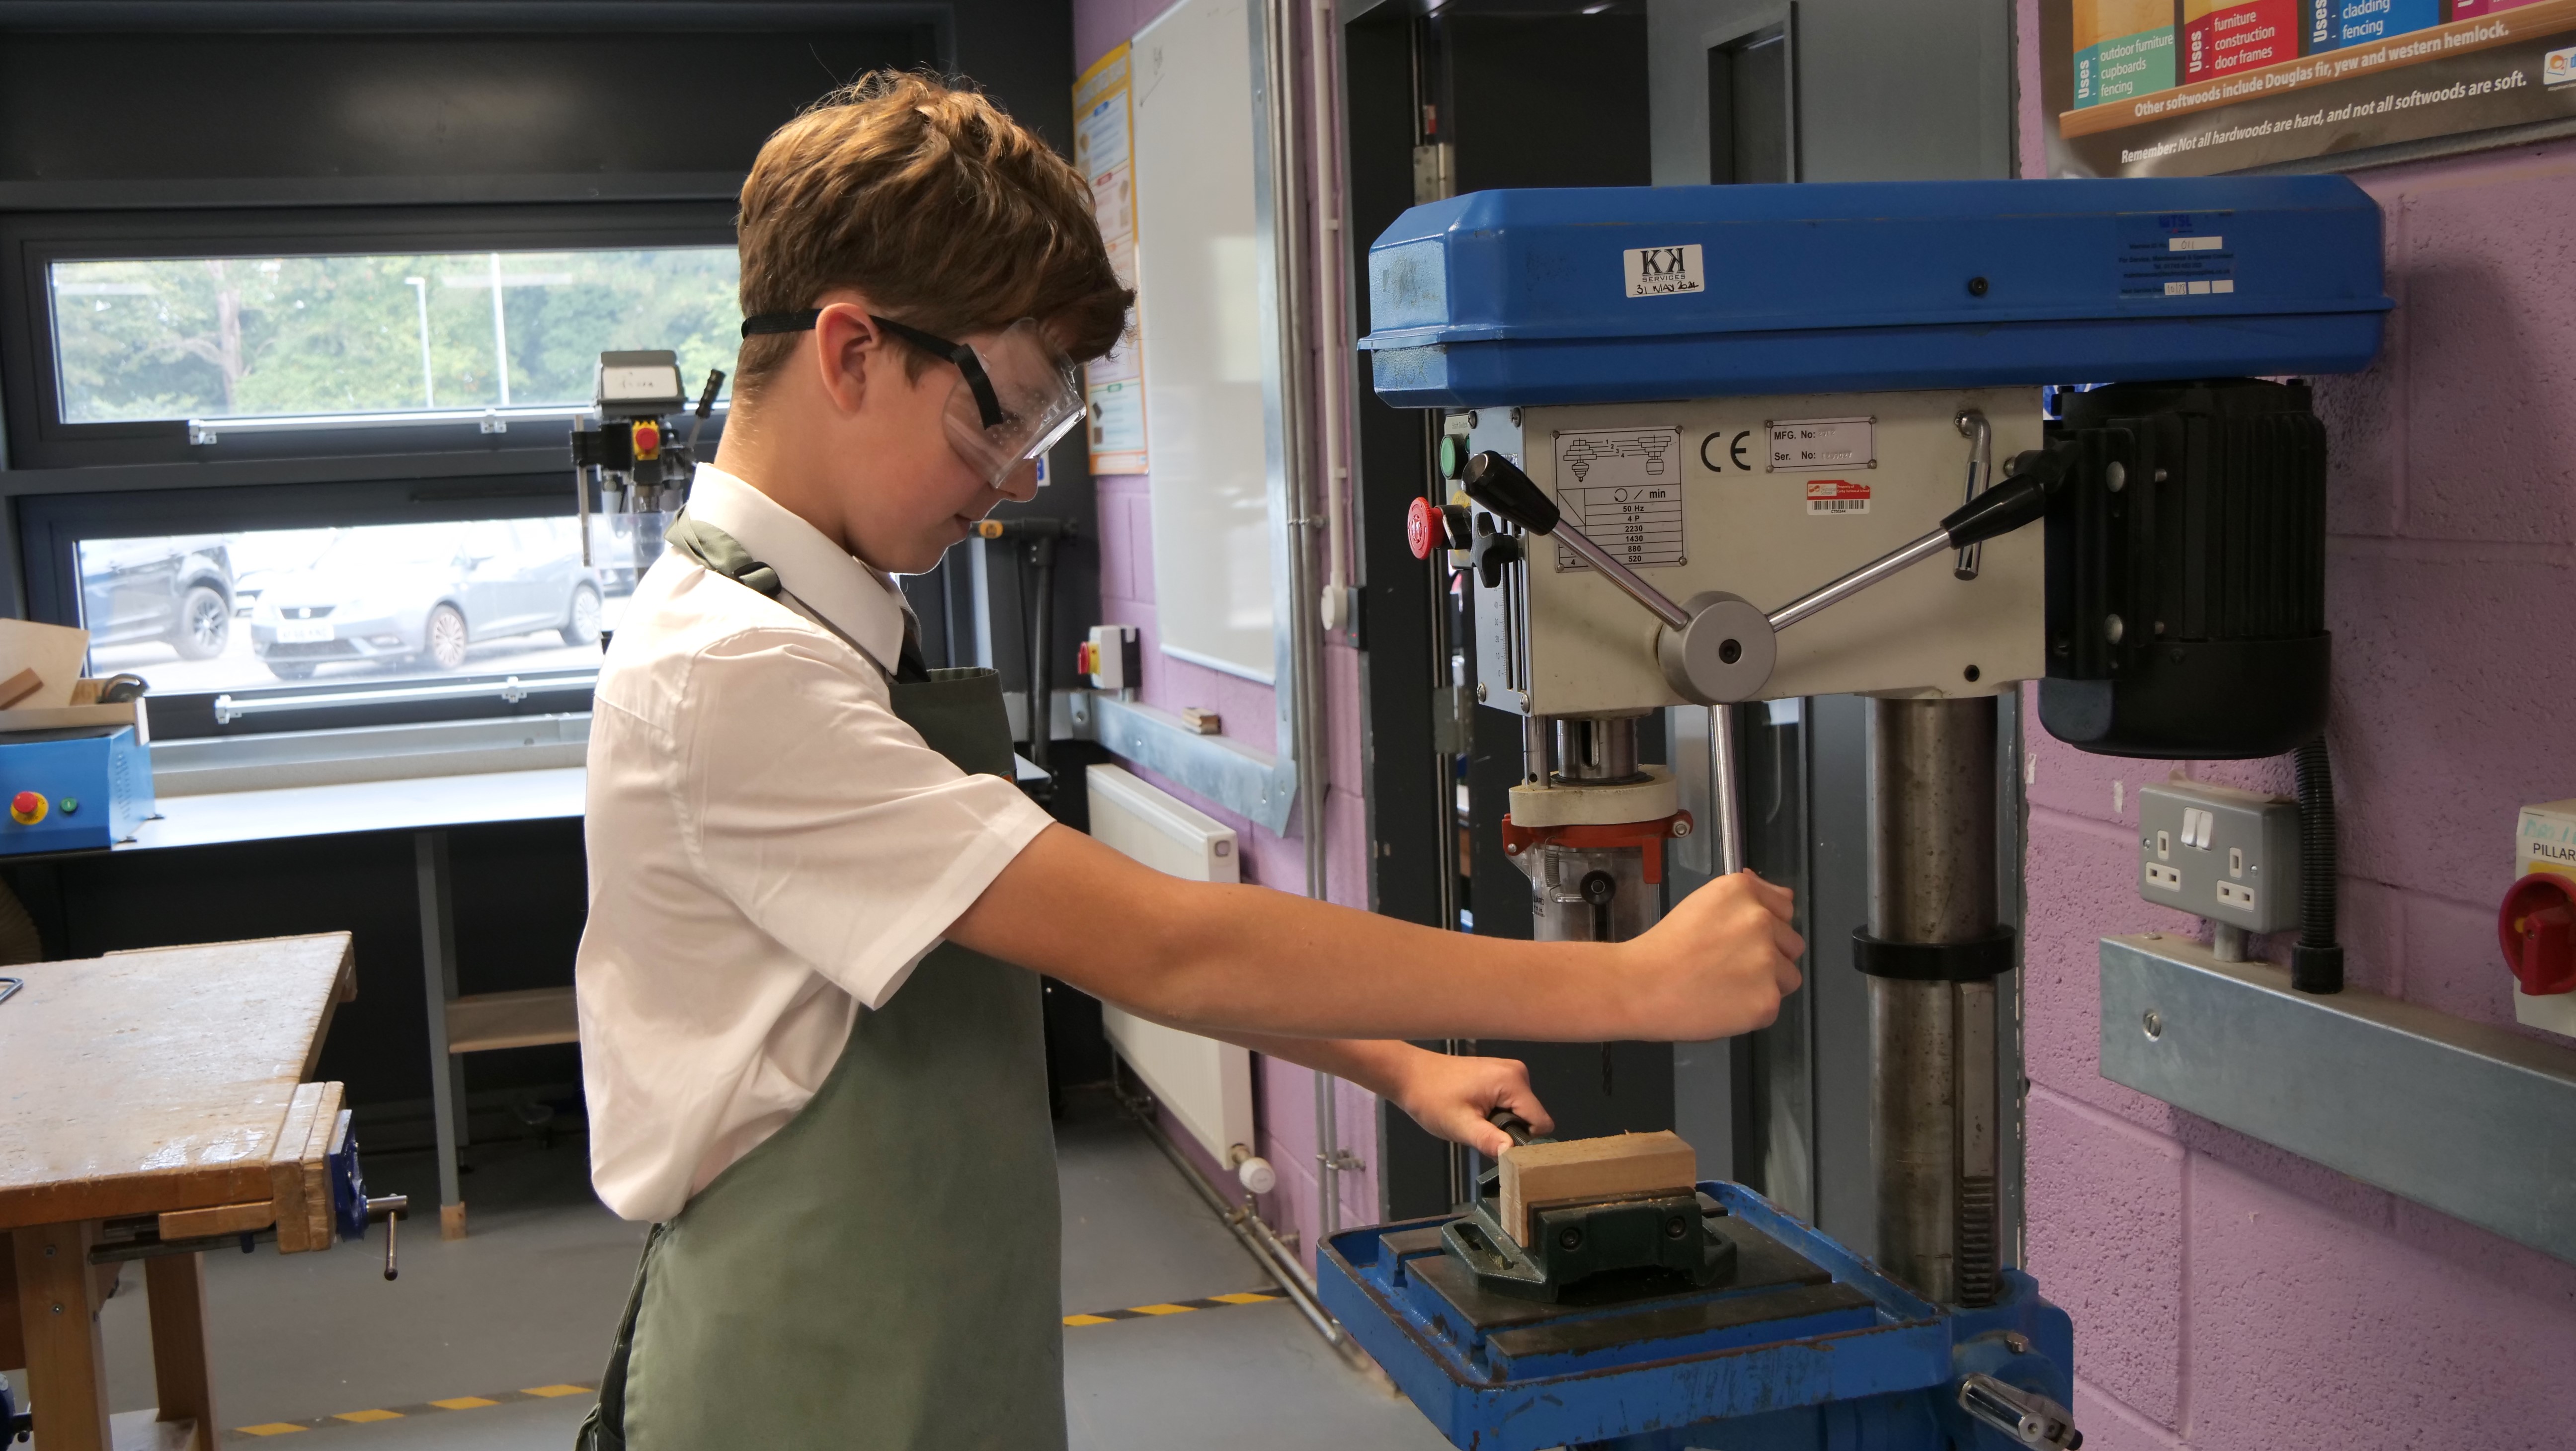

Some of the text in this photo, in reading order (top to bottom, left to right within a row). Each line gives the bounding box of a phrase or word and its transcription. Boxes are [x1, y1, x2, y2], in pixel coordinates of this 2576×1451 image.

[2342, 0, 2390, 19] cladding
[2214, 10, 2256, 32] furniture
[2313, 0, 2328, 43] Uses
[2342, 19, 2383, 39] fencing
[2100, 33, 2174, 62] outdoor furniture
[2215, 25, 2275, 51] construction
[2189, 30, 2202, 73] Uses
[2215, 45, 2273, 70] door frames
[2078, 59, 2089, 99] Uses
[2100, 58, 2146, 80] cupboards
[2135, 21, 2509, 117] Other softwoods include Douglas fir, yew and western hemlock.
[2100, 80, 2133, 97] fencing
[2121, 142, 2176, 163] Remember:
[2178, 138, 2197, 152] Not
[2198, 132, 2211, 148] all
[2212, 120, 2272, 145] hardwoods
[2273, 120, 2292, 133] are
[2294, 110, 2324, 130] hard,
[2327, 104, 2351, 122] and
[2352, 100, 2375, 118] not
[2377, 95, 2393, 113] all
[2395, 82, 2466, 110] softwoods
[2468, 81, 2492, 96] are
[2494, 70, 2527, 91] soft.
[1636, 284, 1648, 294] 31
[1774, 431, 1796, 440] MFG.
[1700, 431, 1751, 472] CE
[1774, 452, 1791, 461] Ser.
[1801, 451, 1816, 460] No:
[1649, 489, 1666, 498] min
[2533, 843, 2576, 861] PILLAR
